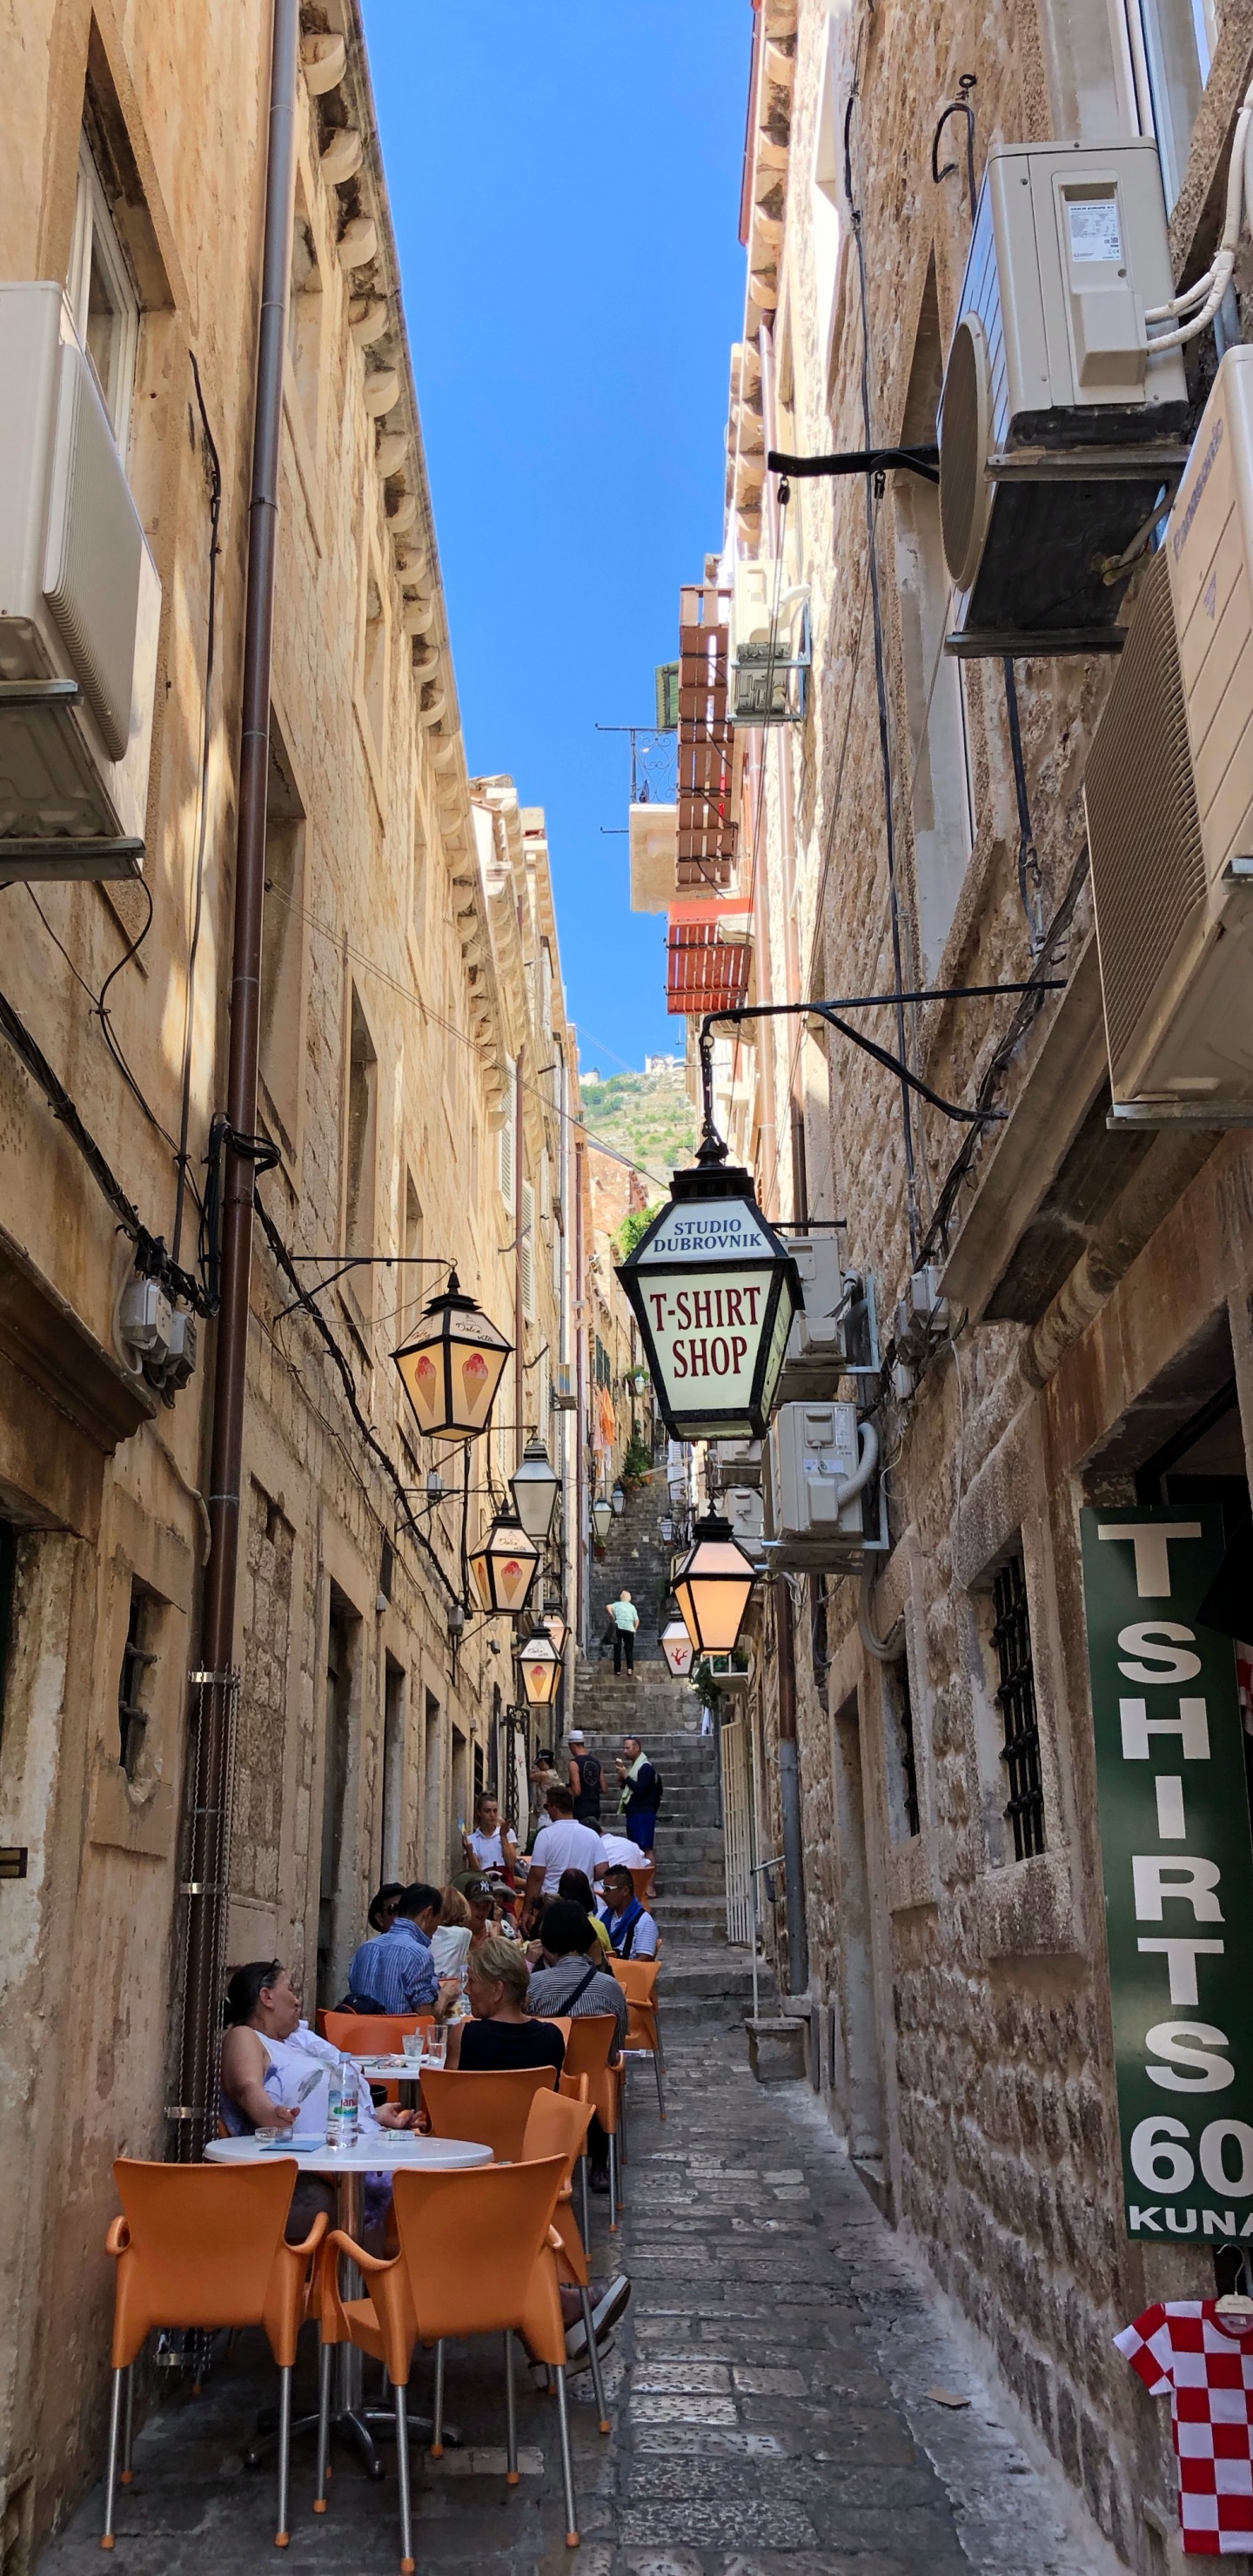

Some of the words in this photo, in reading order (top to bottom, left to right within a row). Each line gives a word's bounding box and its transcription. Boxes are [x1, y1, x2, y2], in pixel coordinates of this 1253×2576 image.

[653, 1233, 762, 1252] DUBROVNIK
[674, 1218, 741, 1236] STUDIO
[649, 1286, 761, 1332] T-SHIRT
[456, 1322, 482, 1334] Dolce
[672, 1336, 747, 1379] SHOP
[1130, 2116, 1253, 2198] 60
